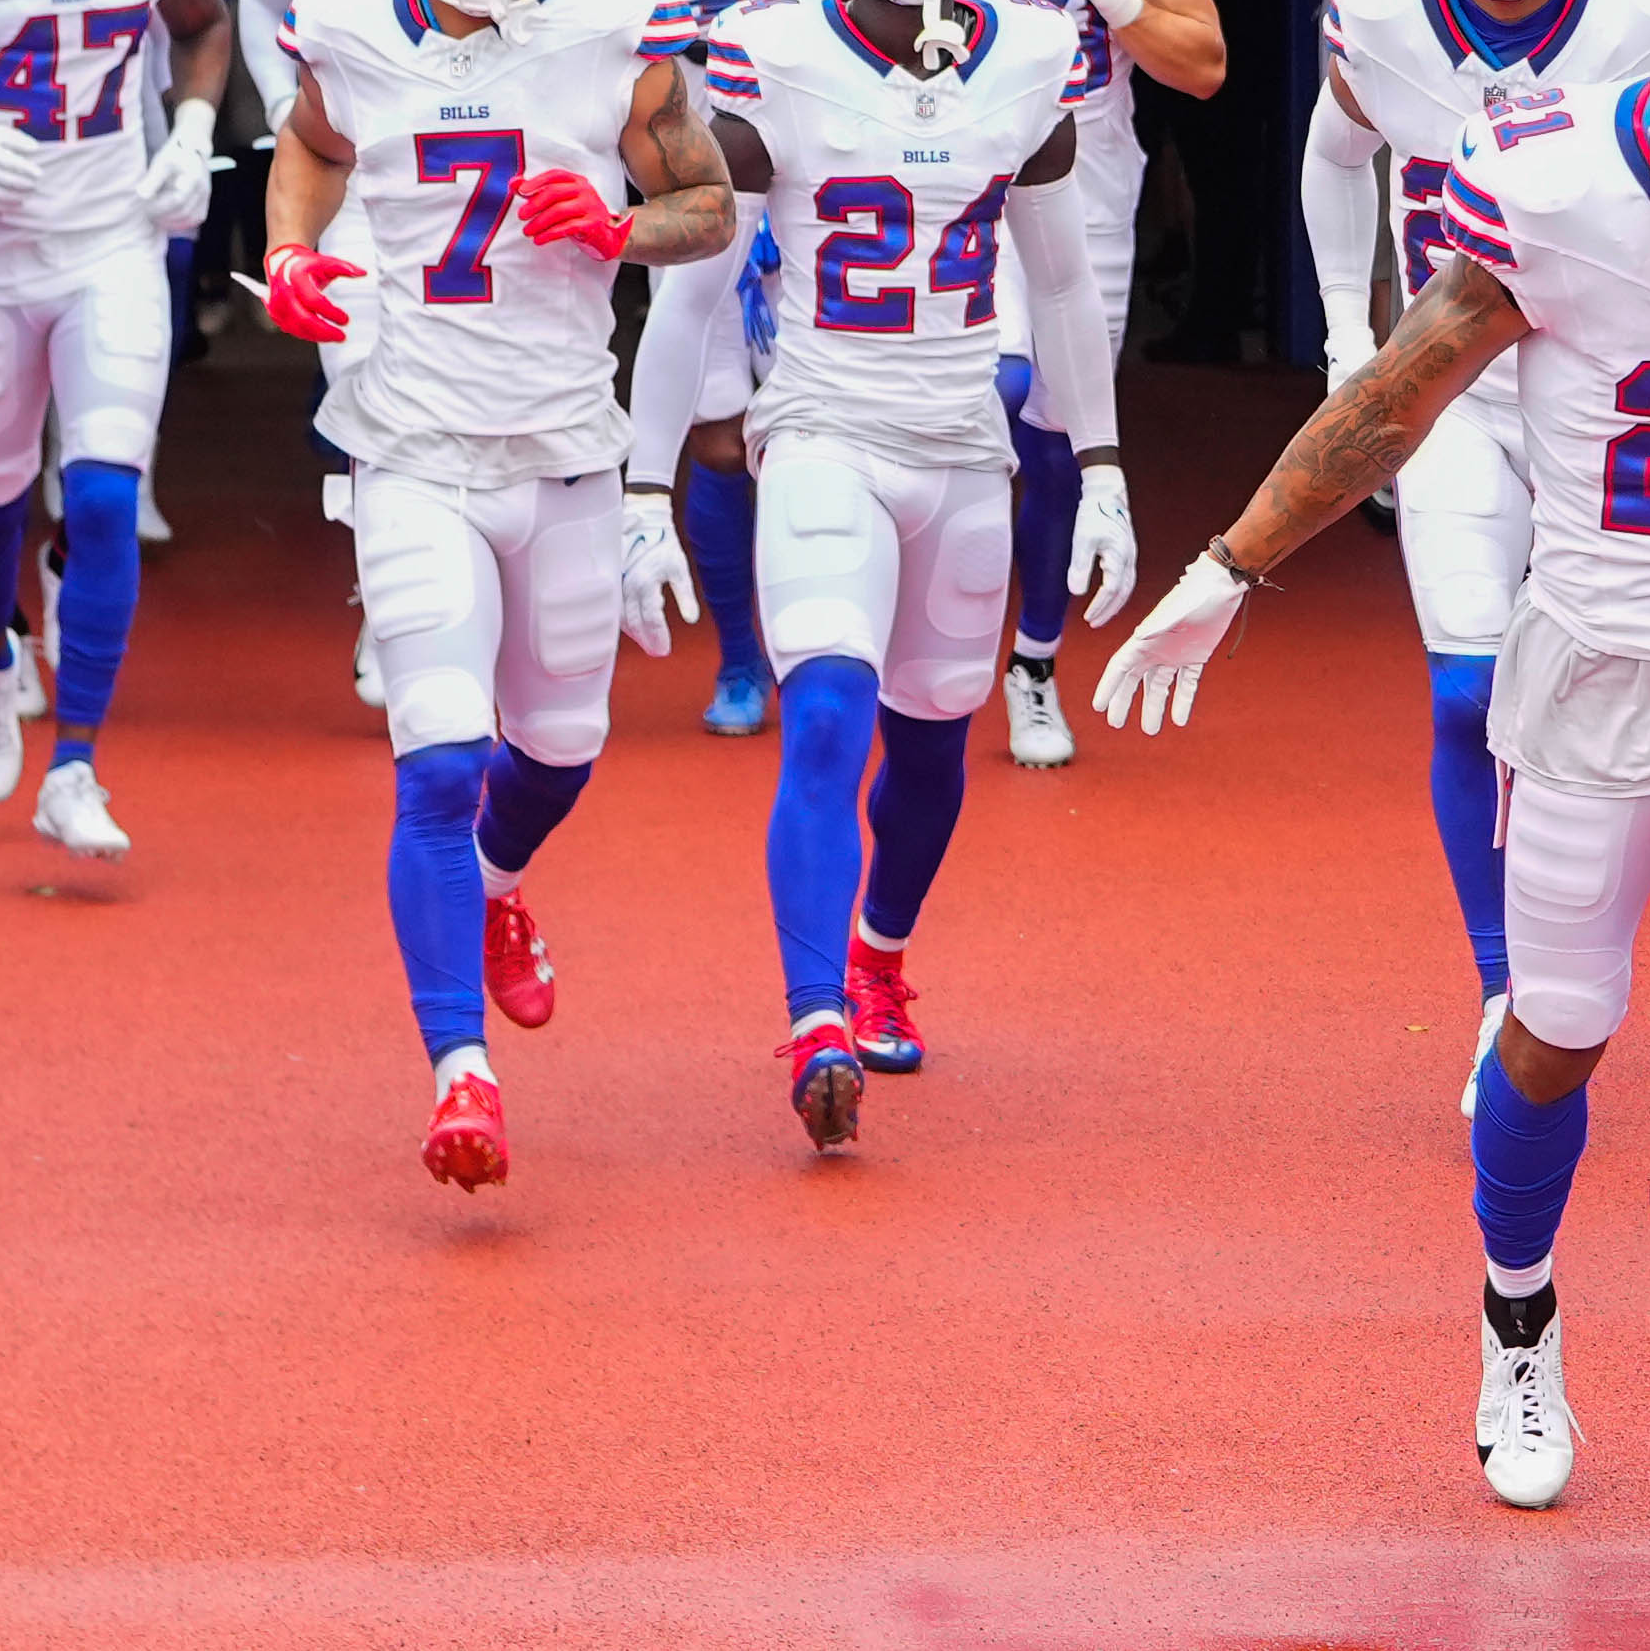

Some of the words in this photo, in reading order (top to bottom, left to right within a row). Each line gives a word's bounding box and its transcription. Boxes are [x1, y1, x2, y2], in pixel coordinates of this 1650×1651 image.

[440, 106, 490, 120] BILLS
[903, 151, 950, 164] BILLS
[413, 129, 526, 304] 7
[814, 172, 1016, 334] 24
